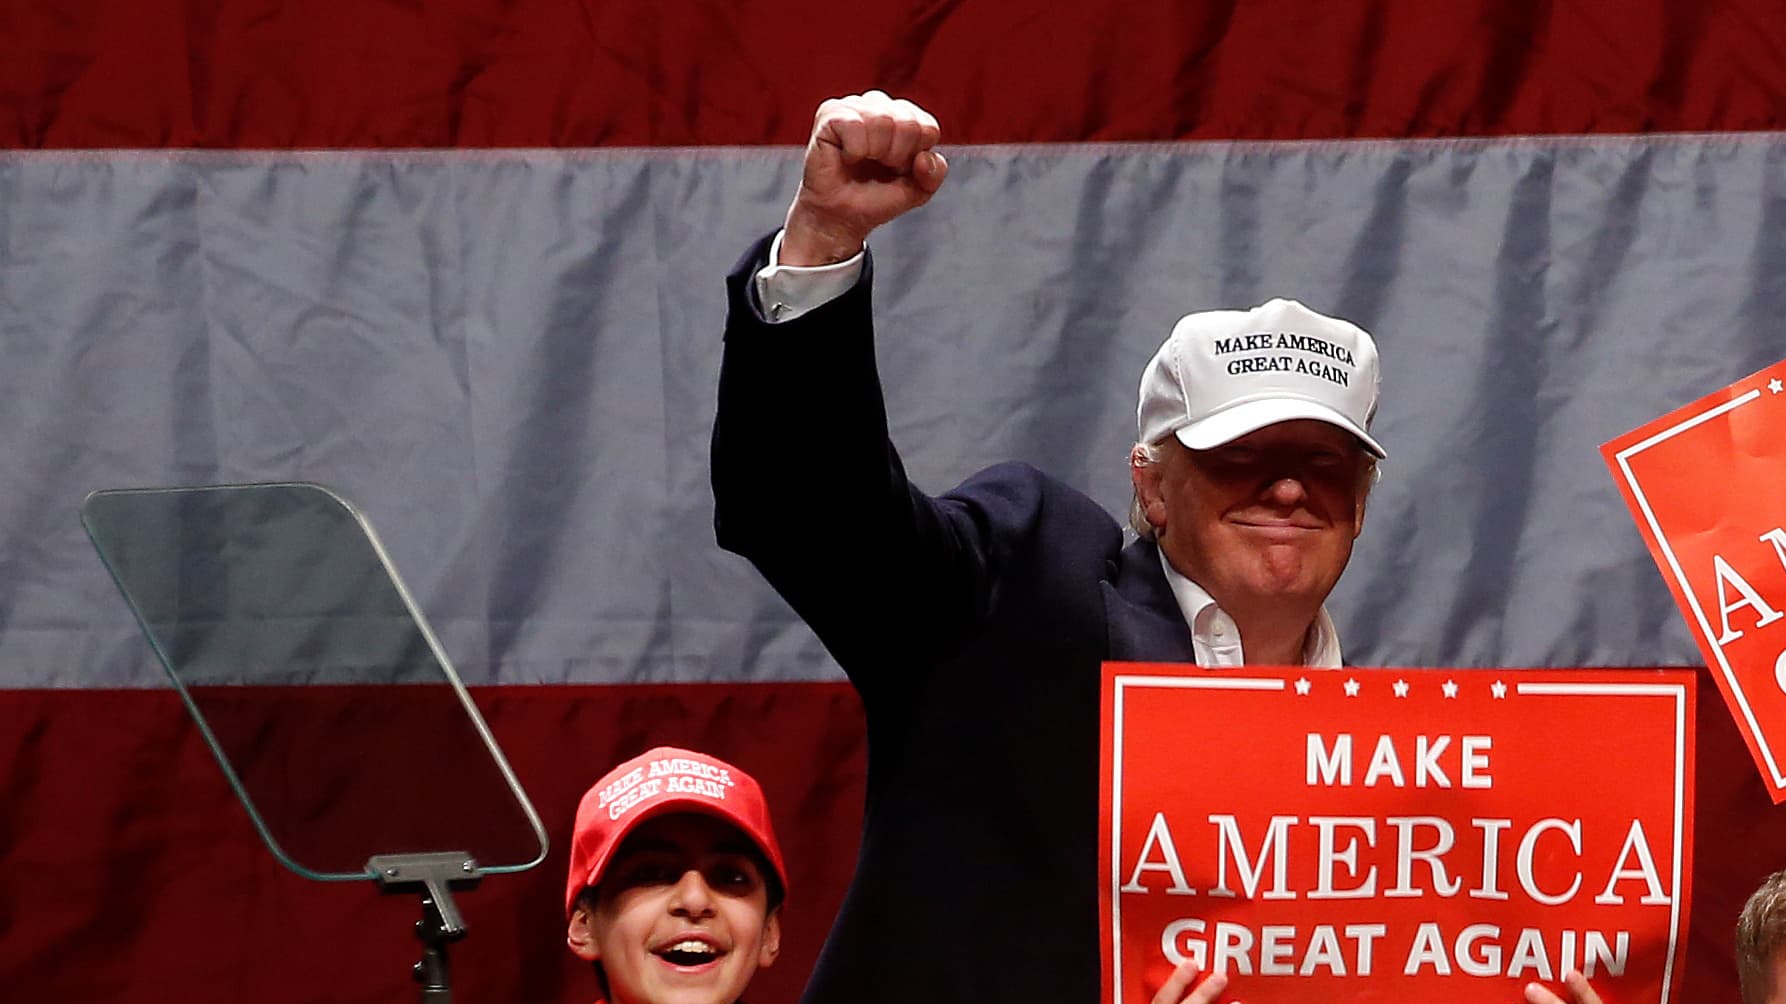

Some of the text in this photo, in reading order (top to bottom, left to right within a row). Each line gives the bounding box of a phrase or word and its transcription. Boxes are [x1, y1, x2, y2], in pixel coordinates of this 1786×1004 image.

[1215, 333, 1356, 367] MAKE AMERICA
[1227, 356, 1349, 387] GREAT AGAIN
[598, 758, 735, 809] MAKE AMERICA
[1305, 733, 1494, 789] MAKE
[609, 777, 726, 820] GREAT AGAIN
[1120, 811, 1672, 906] AMERICA
[1160, 917, 1630, 982] GREAT AGAIN
